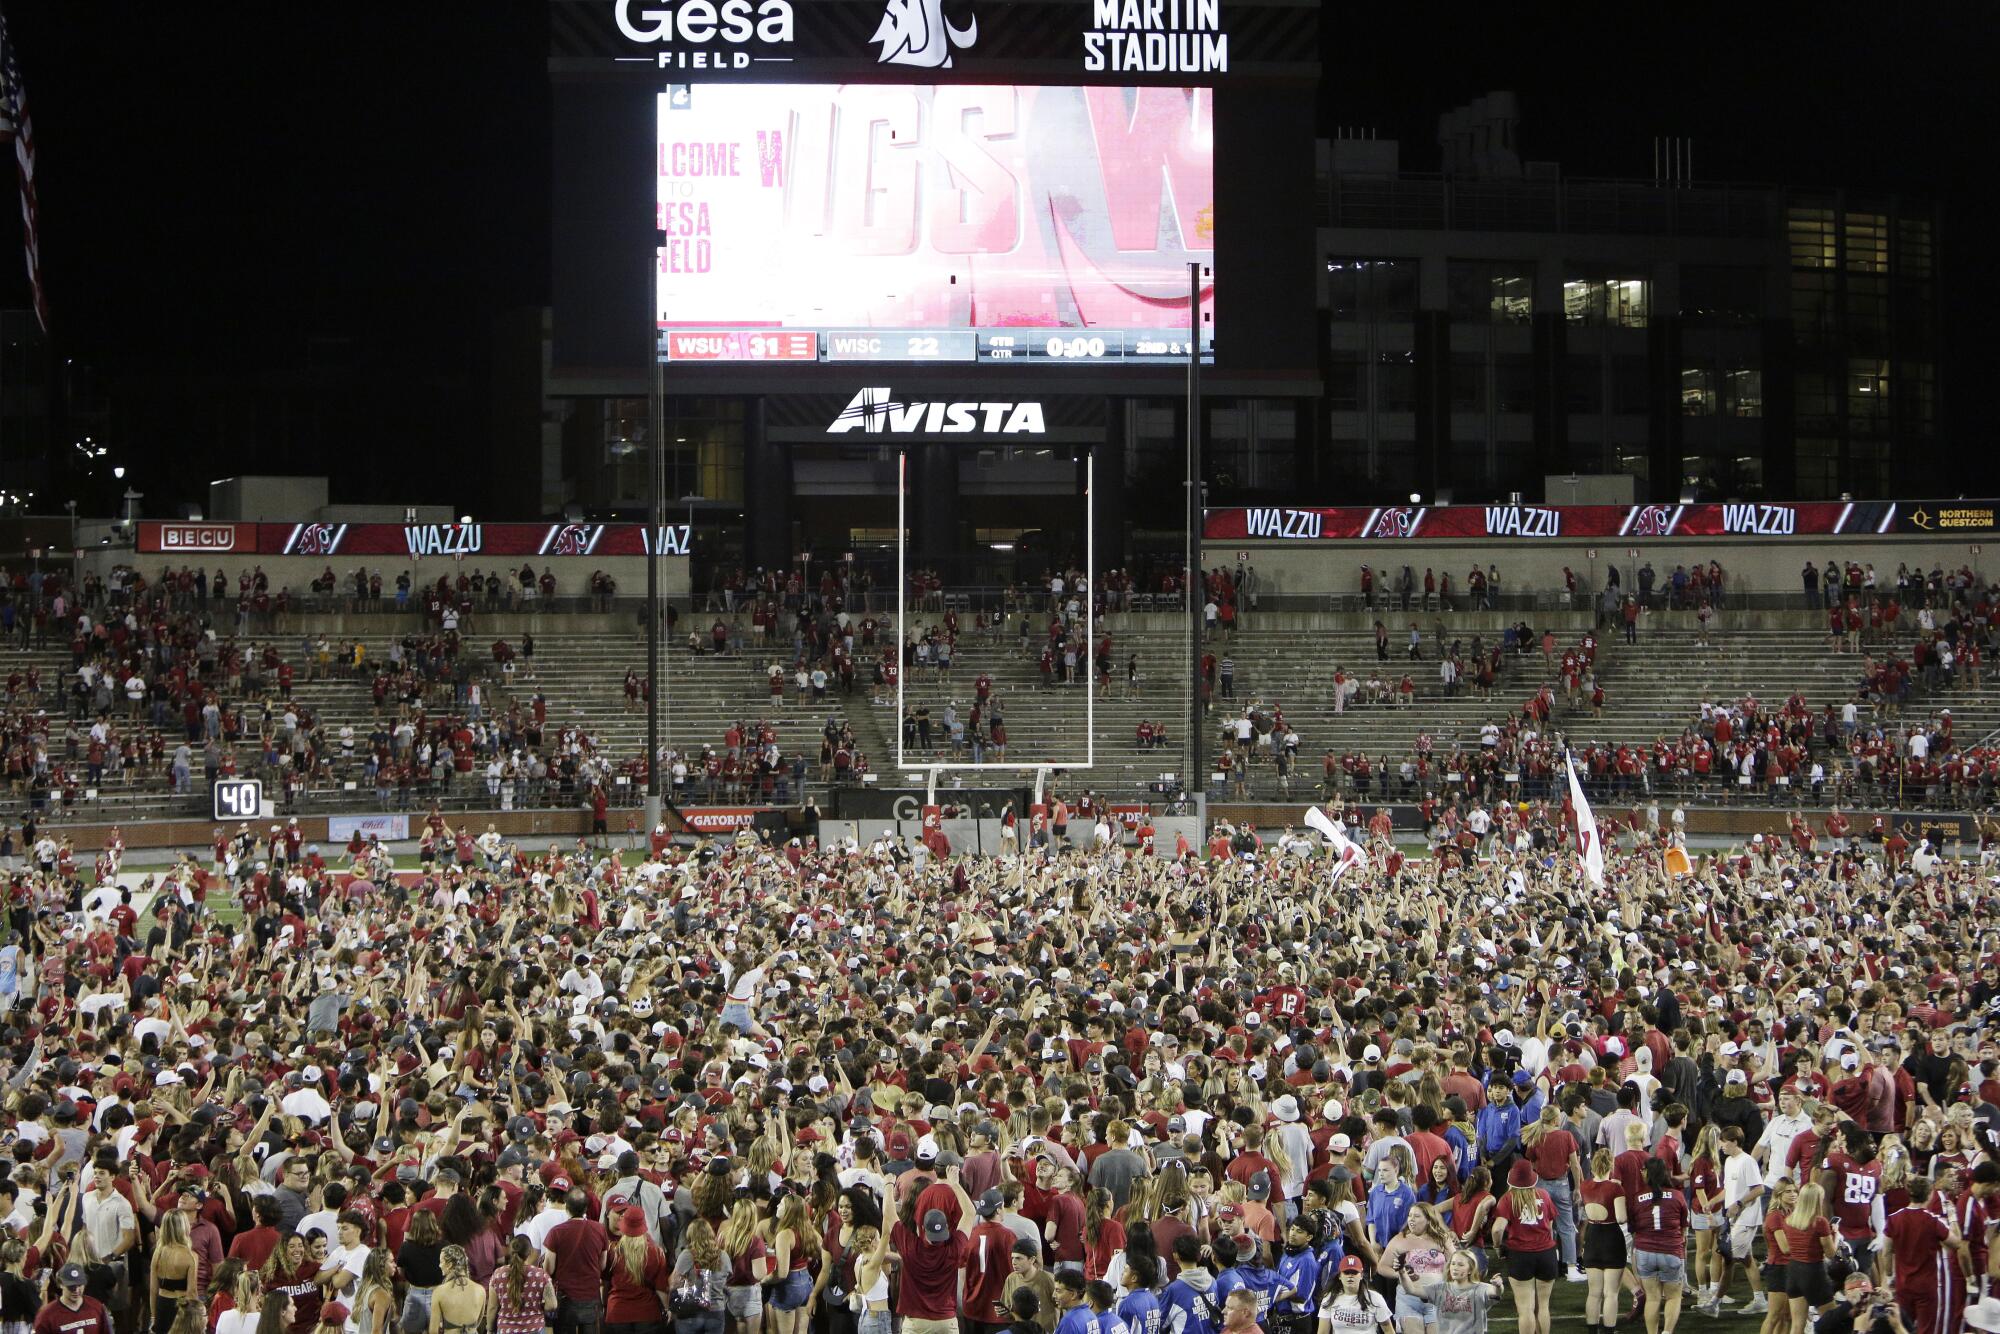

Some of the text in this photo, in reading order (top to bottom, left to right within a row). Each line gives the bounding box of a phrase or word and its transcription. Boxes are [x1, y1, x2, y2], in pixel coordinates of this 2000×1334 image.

[615, 0, 794, 43] Gesa
[1094, 0, 1219, 31] MARTIN
[658, 52, 750, 69] FIELD
[1083, 32, 1228, 72] STADIUM
[677, 338, 723, 354] WSU
[749, 337, 780, 356] 31
[834, 338, 881, 353] WISC
[908, 337, 940, 356] 22
[991, 349, 1012, 359] QTR
[1046, 337, 1105, 358] 0:00
[826, 387, 1046, 433] AVISTA
[1246, 507, 1322, 538] WAZZU
[1485, 506, 1560, 537] WAZZU
[1723, 503, 1796, 535] WAZZU
[1939, 509, 1994, 519] NORTHERN
[1939, 518, 1994, 528] QUEST.COM
[167, 530, 230, 545] BECU
[404, 524, 482, 554] WAZZU
[888, 667, 897, 675] 33
[222, 784, 256, 815] 40
[1281, 993, 1298, 1014] 12
[1638, 1191, 1673, 1203] COURS
[1843, 1172, 1877, 1204] 89
[1652, 1205, 1662, 1230] 1
[979, 1234, 987, 1273] 1
[1333, 1314, 1370, 1325] Cougars
